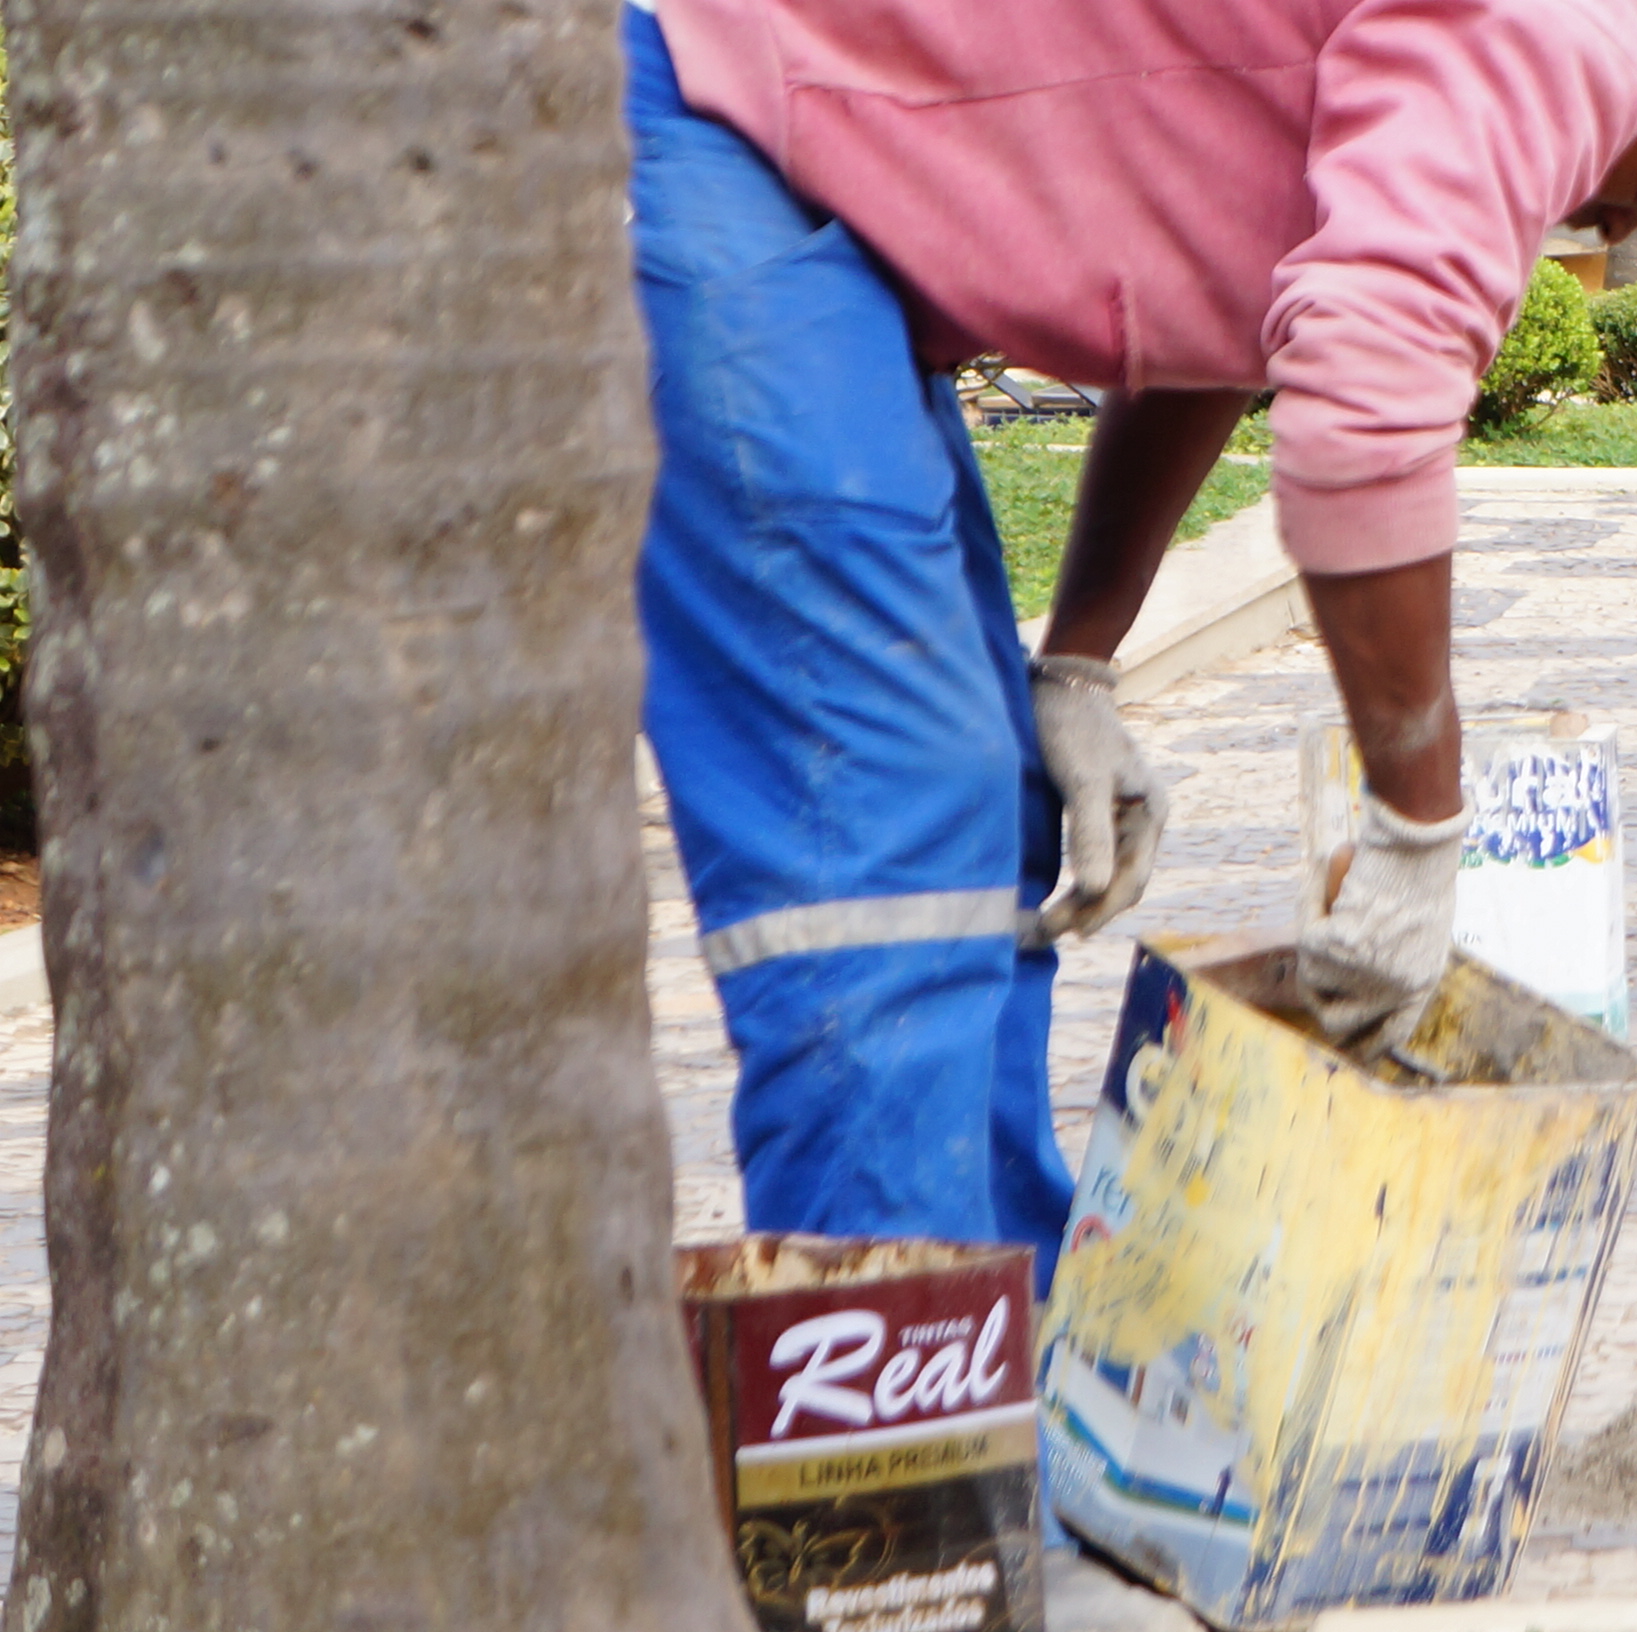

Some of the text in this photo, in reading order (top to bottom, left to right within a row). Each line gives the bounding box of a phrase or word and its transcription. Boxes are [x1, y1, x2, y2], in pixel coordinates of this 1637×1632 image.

[769, 1293, 1009, 1440] Real
[799, 1434, 989, 1489] LINHA PREMIUM
